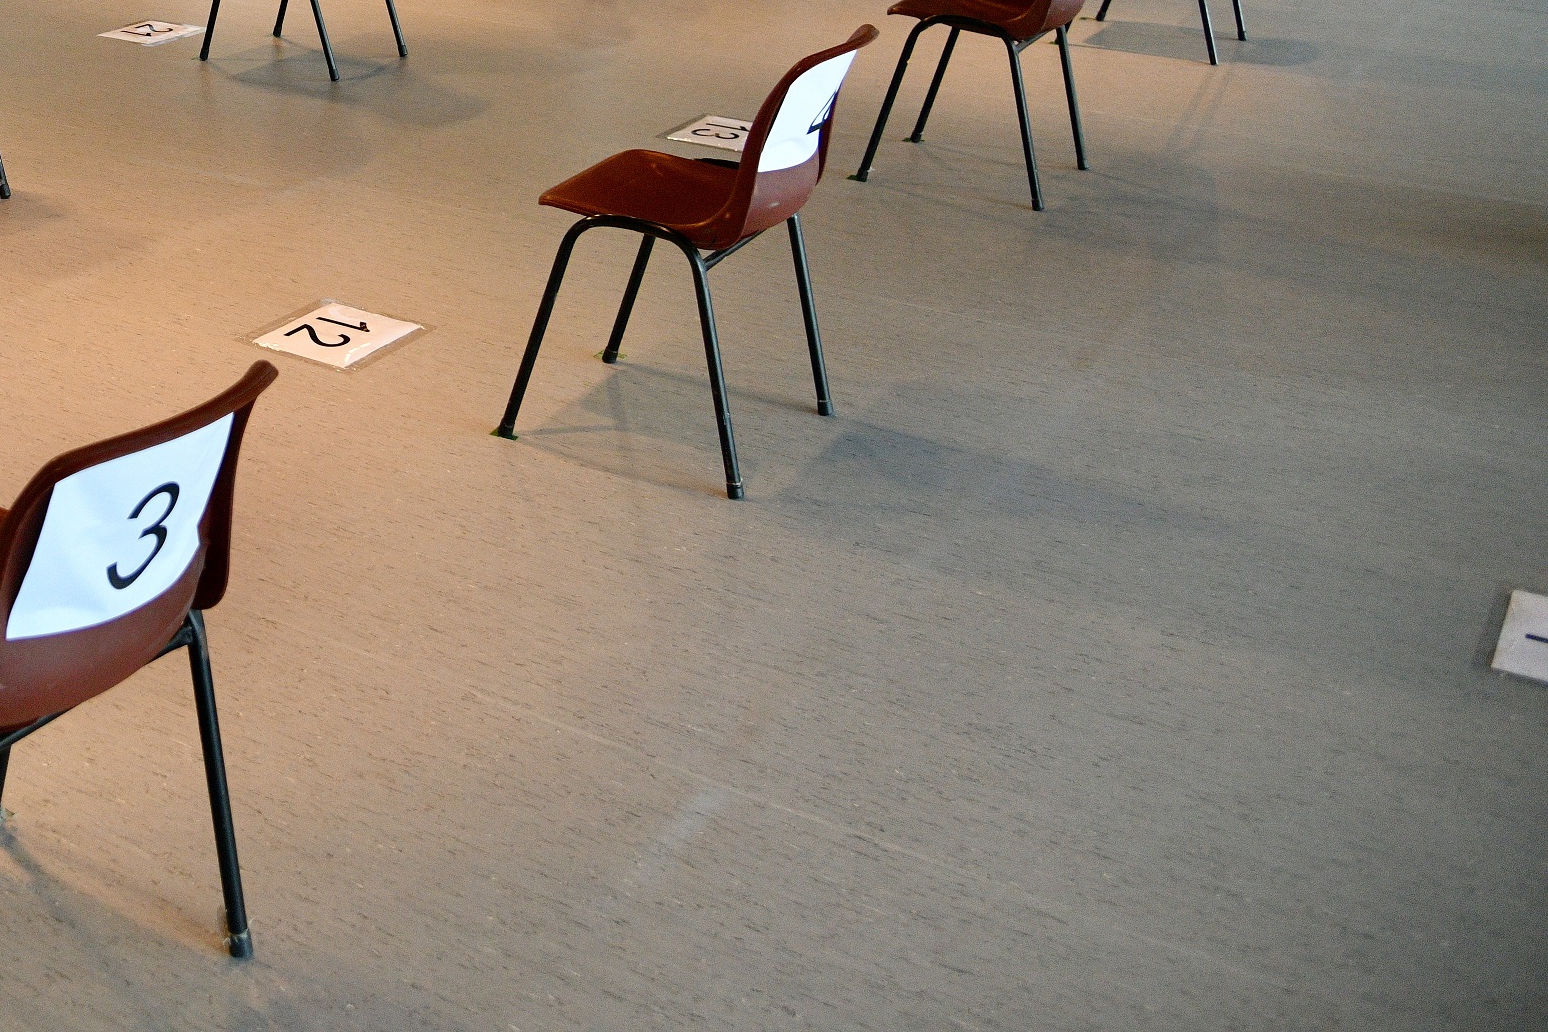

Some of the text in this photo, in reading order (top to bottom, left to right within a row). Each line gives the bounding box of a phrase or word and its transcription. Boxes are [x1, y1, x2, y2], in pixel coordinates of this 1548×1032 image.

[119, 23, 174, 37] 21
[690, 122, 751, 140] 13
[283, 316, 371, 348] 12
[106, 480, 181, 590] 3
